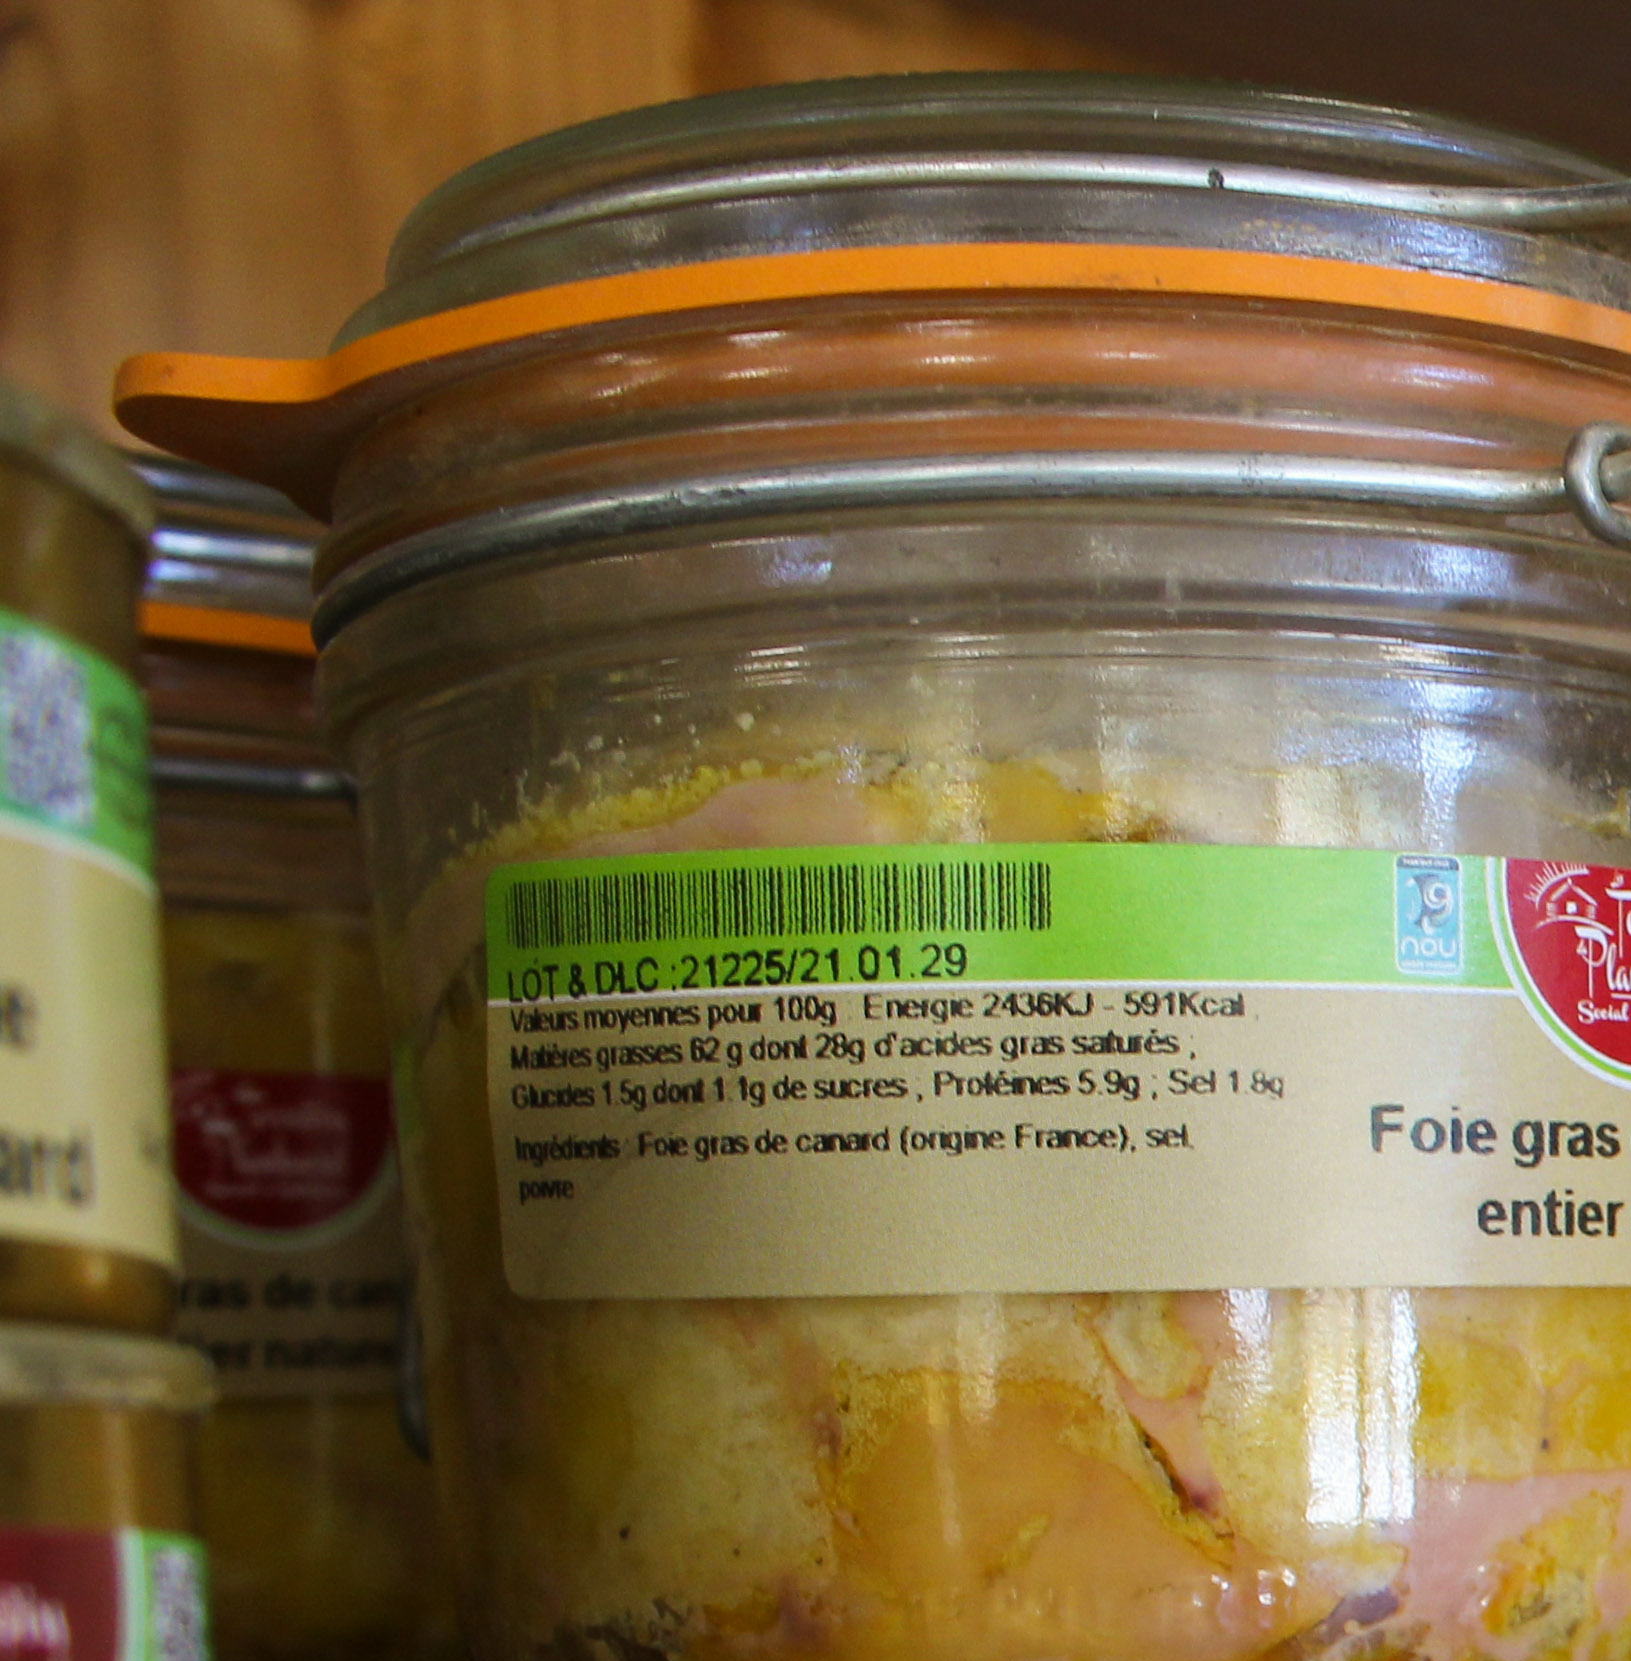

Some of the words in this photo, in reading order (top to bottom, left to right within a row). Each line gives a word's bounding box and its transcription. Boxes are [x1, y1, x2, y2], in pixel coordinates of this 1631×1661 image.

[508, 963, 560, 1003] LOT
[568, 964, 588, 999] &
[594, 956, 660, 996] DLC
[510, 1007, 580, 1033] Valeurs
[584, 1003, 701, 1034] moyennes
[708, 1000, 763, 1031] pour
[775, 995, 838, 1028] 100g
[1123, 990, 1246, 1017] 591Kcal
[597, 1042, 683, 1073] grasses
[727, 1040, 743, 1068] g
[750, 1034, 808, 1061] dont
[815, 1032, 866, 1064] 28g
[874, 1031, 994, 1057] d'acides
[1000, 1034, 1066, 1062] gras
[653, 1077, 706, 1105] dont
[773, 1075, 808, 1101] de
[813, 1077, 909, 1099] sucres
[1168, 1068, 1218, 1095] Sel
[638, 1130, 690, 1157] Foie
[695, 1133, 749, 1162] gras
[755, 1129, 788, 1154] de
[796, 1125, 891, 1153] canard
[900, 1125, 1006, 1157] (origine
[1369, 1101, 1498, 1155] Foie
[1511, 1119, 1621, 1168] gras
[1477, 1187, 1623, 1238] entier
